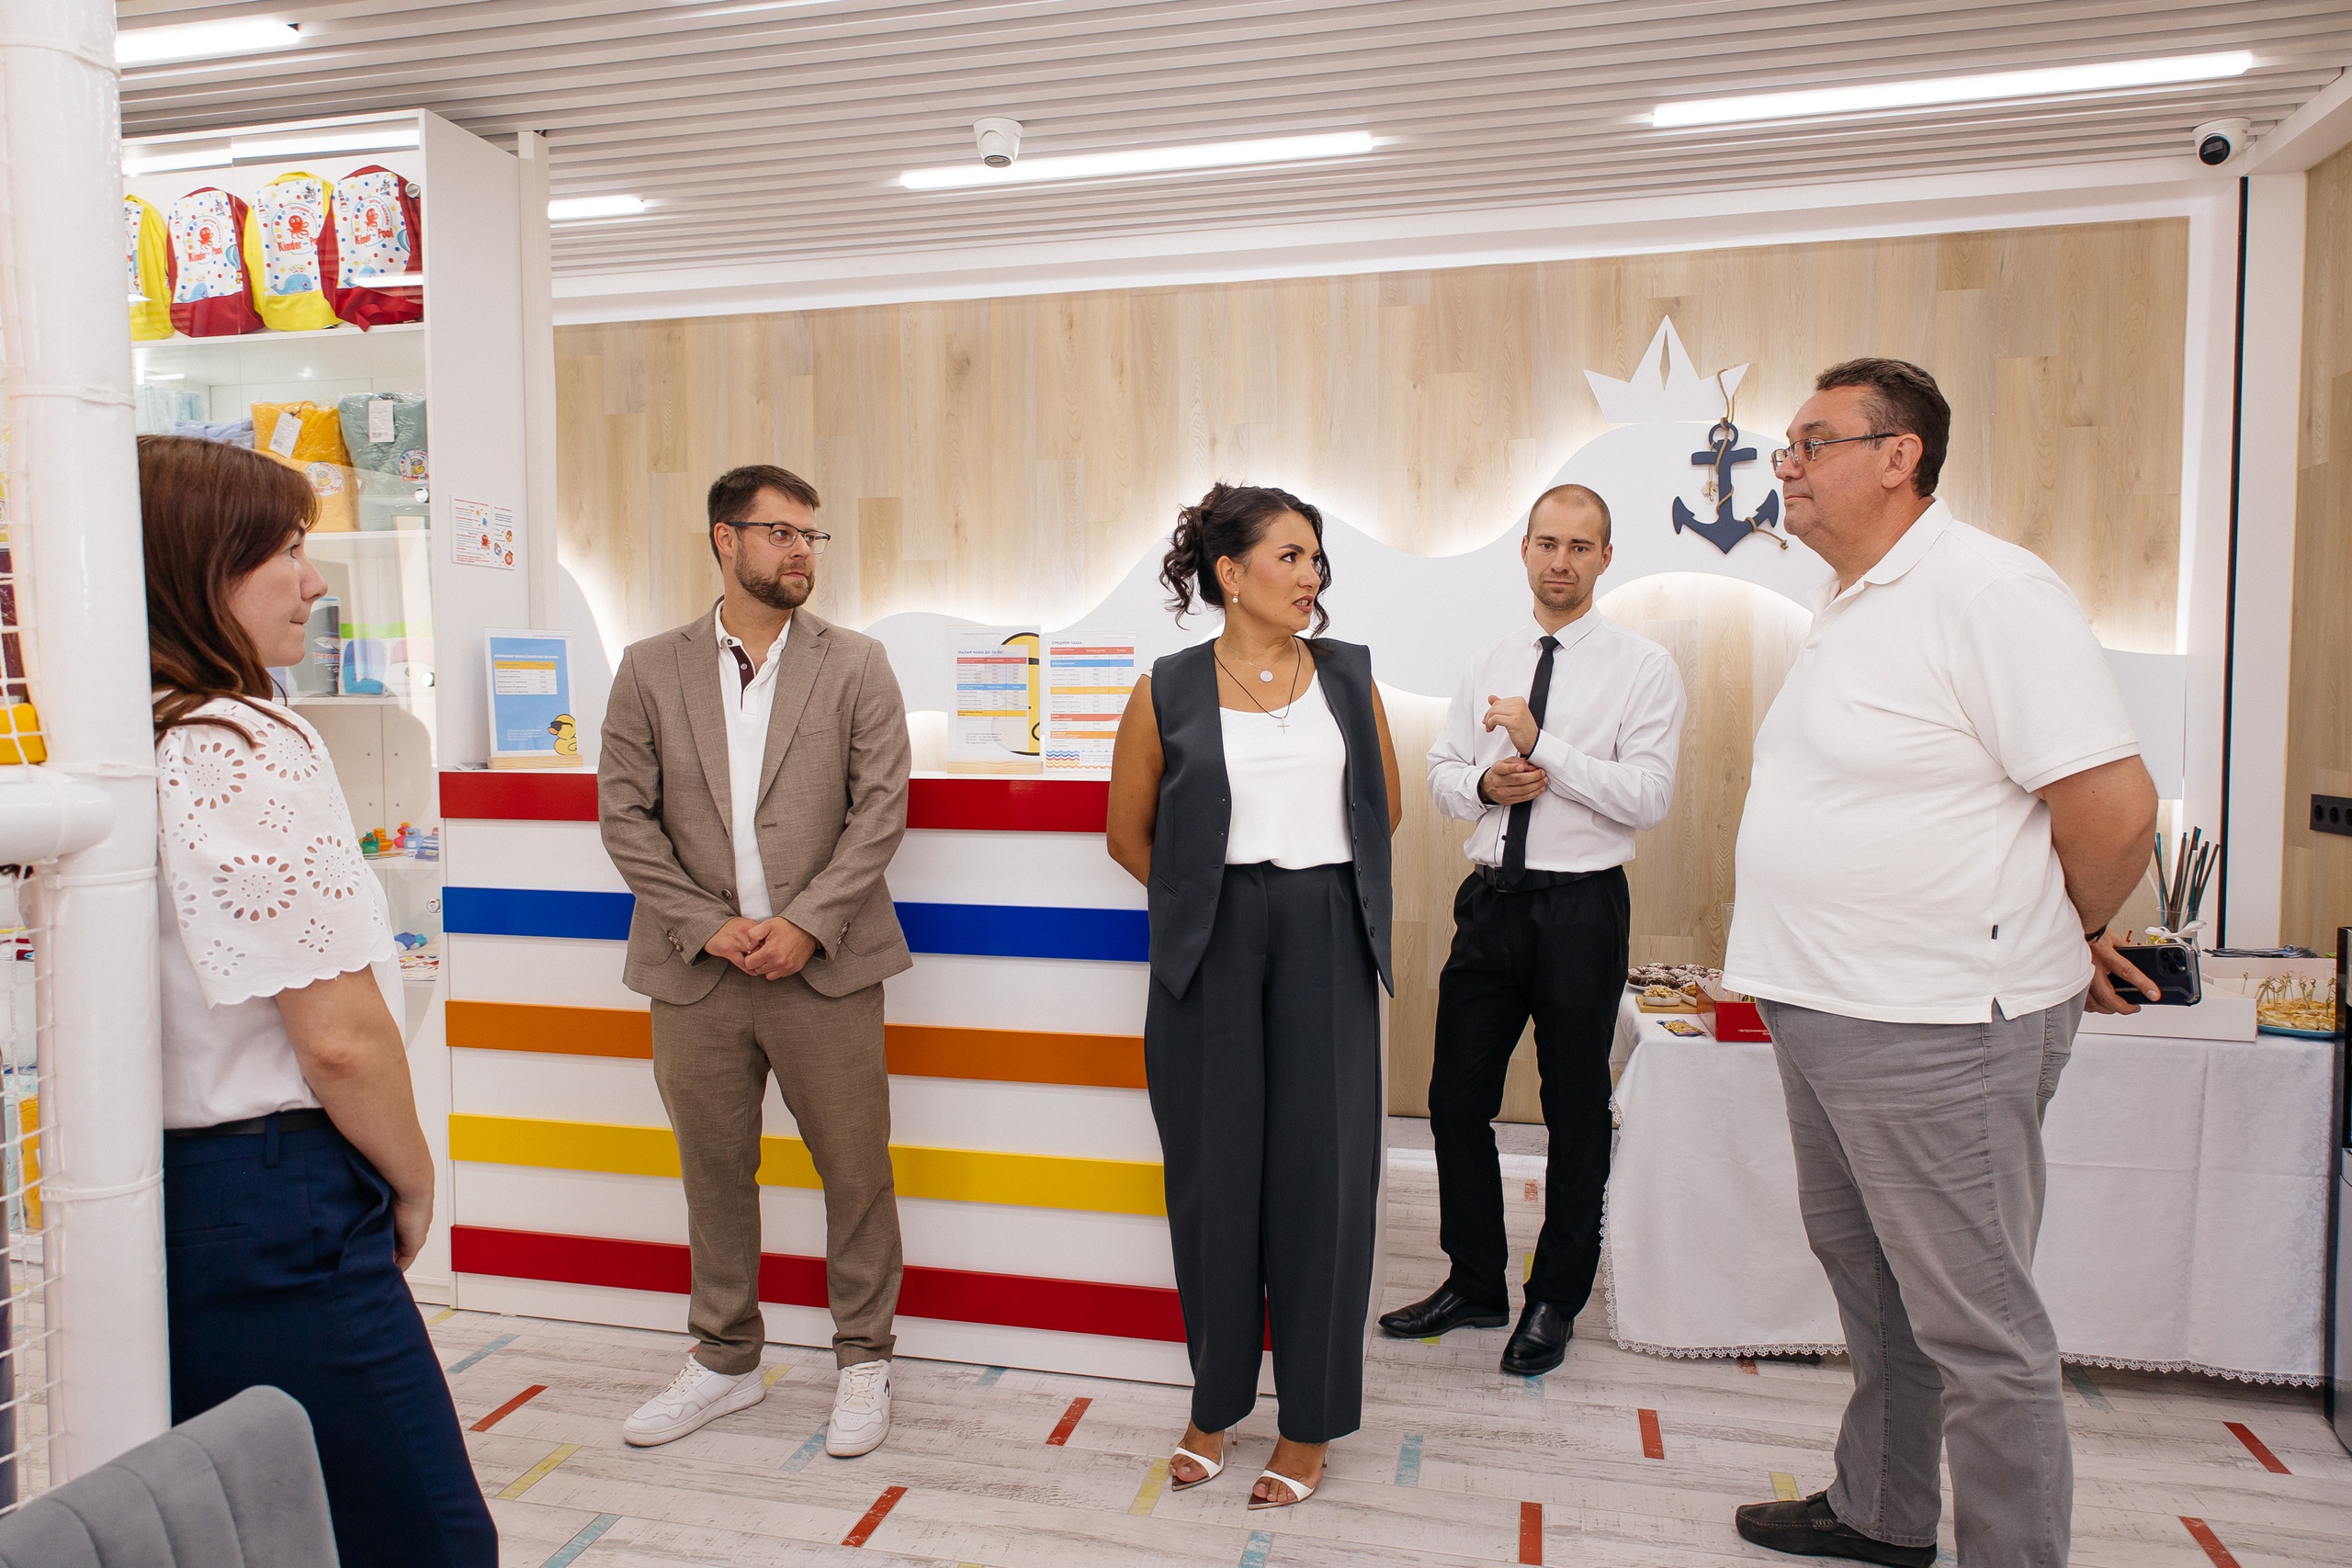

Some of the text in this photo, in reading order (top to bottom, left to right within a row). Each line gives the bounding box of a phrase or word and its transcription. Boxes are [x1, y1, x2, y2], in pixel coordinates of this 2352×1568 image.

[355, 227, 394, 244] Kinder Pool
[277, 236, 318, 252] Kinder Po
